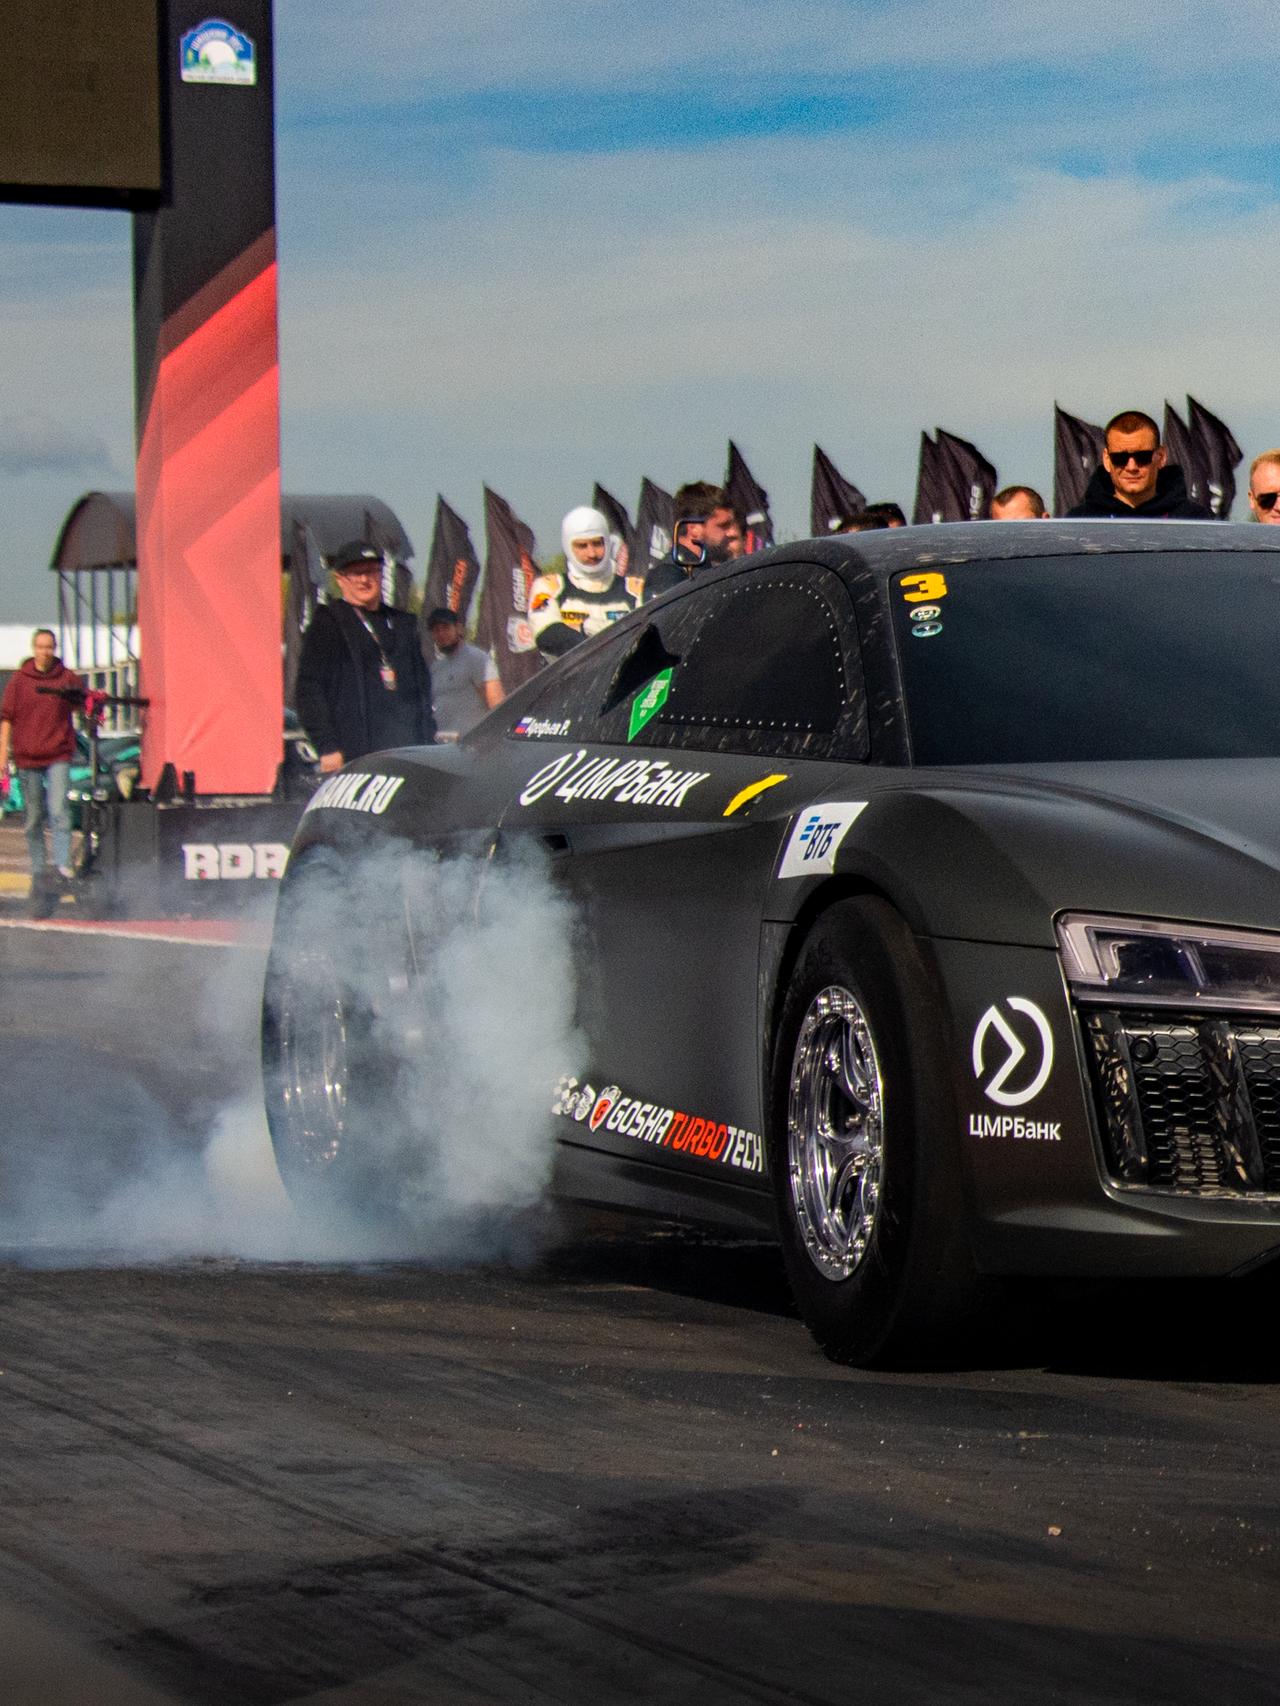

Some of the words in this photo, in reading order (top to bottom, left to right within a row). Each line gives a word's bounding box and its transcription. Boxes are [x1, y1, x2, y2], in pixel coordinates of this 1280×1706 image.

[900, 572, 948, 602] 3
[554, 757, 710, 808] ЦМРБанк
[802, 822, 842, 861] ВТБ
[969, 1113, 1062, 1141] ЦМРБанк
